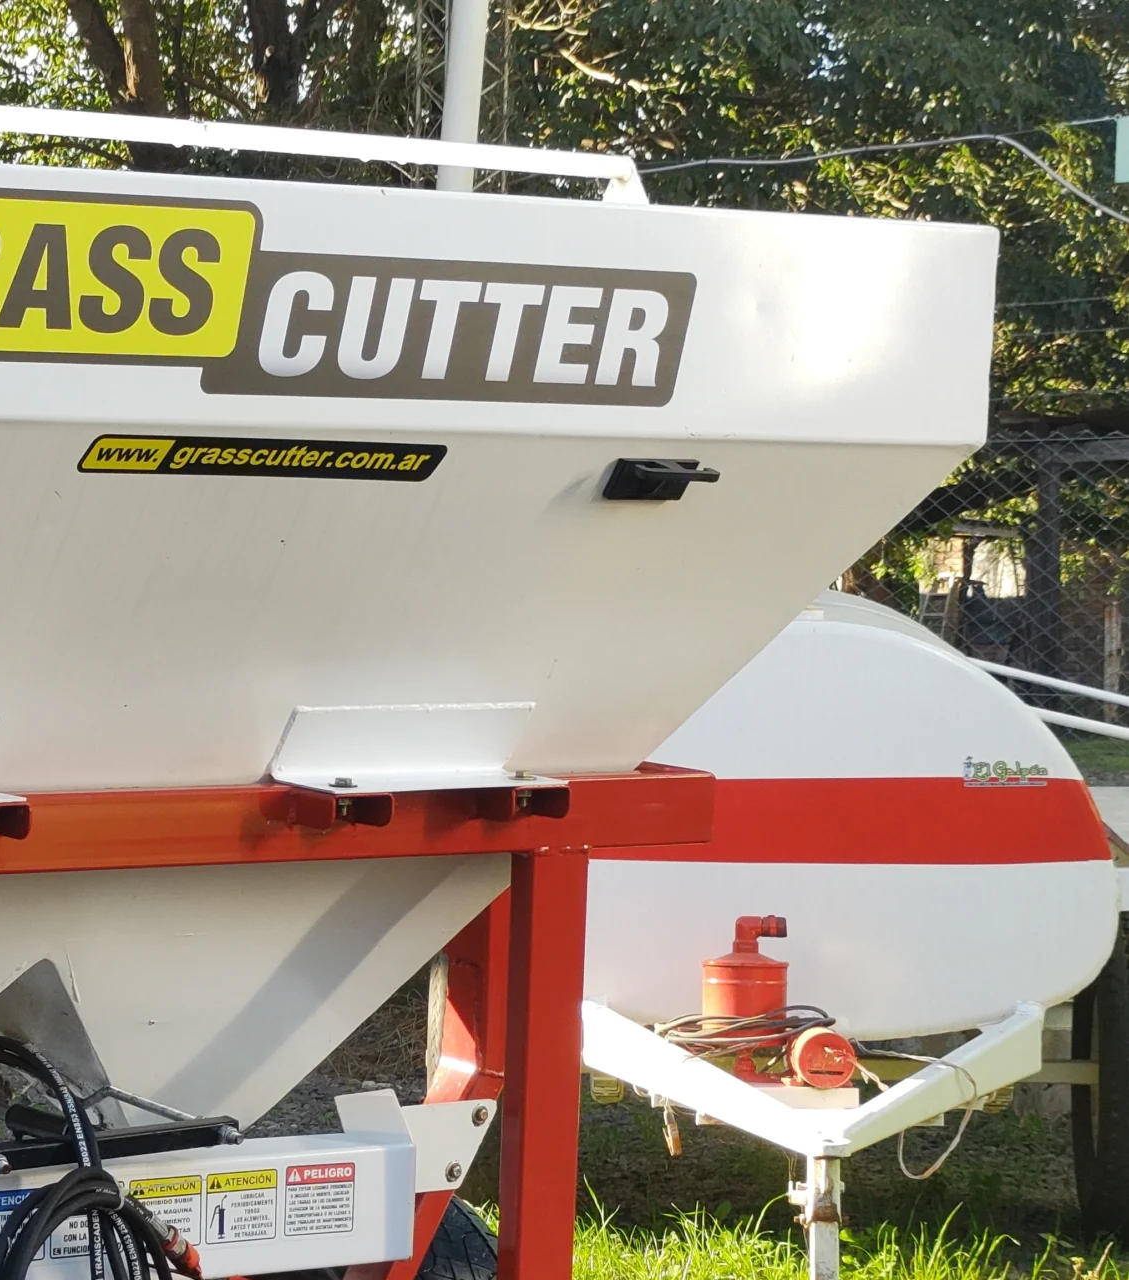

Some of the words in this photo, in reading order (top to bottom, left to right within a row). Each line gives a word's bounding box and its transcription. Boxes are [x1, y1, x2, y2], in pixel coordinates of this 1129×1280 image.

[256, 269, 671, 389] CUTTER
[303, 1166, 353, 1180] PELIGRO
[224, 1174, 272, 1187] ATENCIÓN
[69, 1220, 79, 1229] NO
[63, 1233, 77, 1242] CON
[78, 1233, 87, 1241] LA
[123, 1234, 138, 1260] EN853
